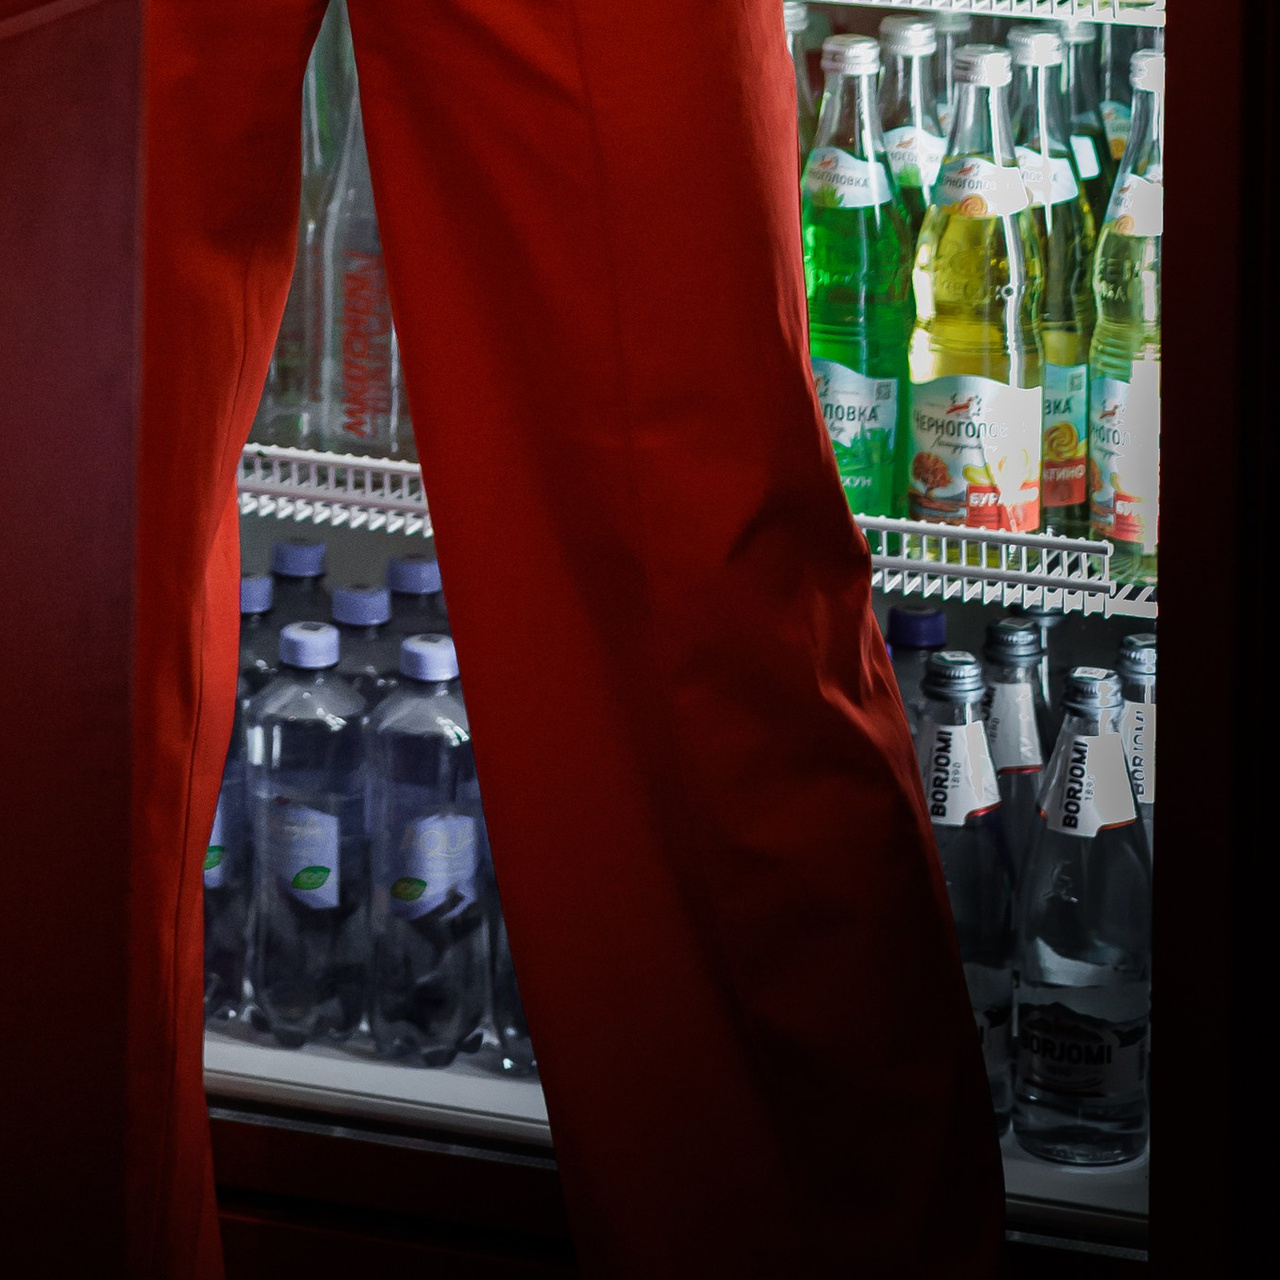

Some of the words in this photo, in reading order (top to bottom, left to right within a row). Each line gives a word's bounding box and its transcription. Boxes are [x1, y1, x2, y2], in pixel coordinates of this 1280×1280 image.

[930, 730, 953, 817] BORJOMI
[1062, 740, 1089, 830] BORJOMI
[1023, 1028, 1113, 1066] BORJOMI
